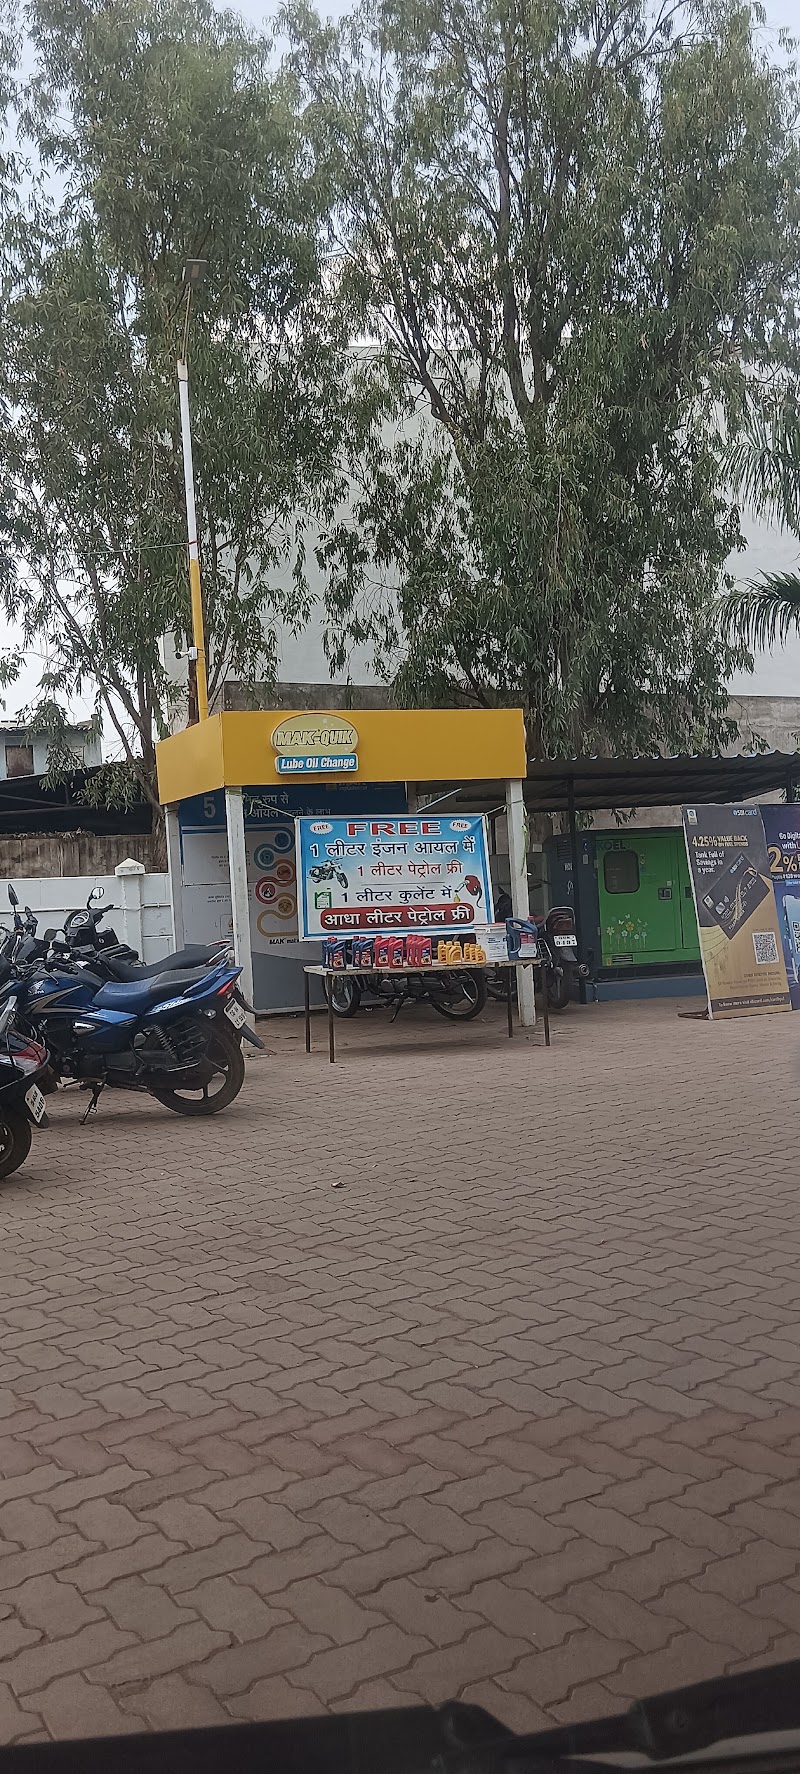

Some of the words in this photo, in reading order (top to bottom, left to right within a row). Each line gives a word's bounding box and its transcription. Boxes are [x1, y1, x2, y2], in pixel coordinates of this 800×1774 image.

[281, 758, 304, 769] Lube
[306, 758, 318, 768] Oil
[321, 757, 355, 769] Change
[203, 797, 216, 818] 5
[347, 821, 440, 836] FREE
[310, 844, 319, 857] 1
[325, 838, 366, 856] लीटर
[371, 838, 408, 856] इंजन
[415, 841, 458, 854] आयल
[463, 836, 476, 853] में
[692, 836, 717, 847] 4.25%
[357, 865, 364, 876] 1
[371, 861, 402, 876] लीटर
[408, 860, 441, 877] पेट्रोल
[445, 859, 463, 874] फ्री
[696, 859, 717, 867] Savings
[341, 892, 349, 902] 1
[356, 887, 393, 902] लीटर
[399, 886, 435, 904] कुलेंट
[441, 885, 452, 899] में
[324, 912, 360, 926] आधा
[366, 909, 402, 924] लीटर
[408, 907, 445, 925] पेट्रोल
[451, 905, 471, 921] फ्री
